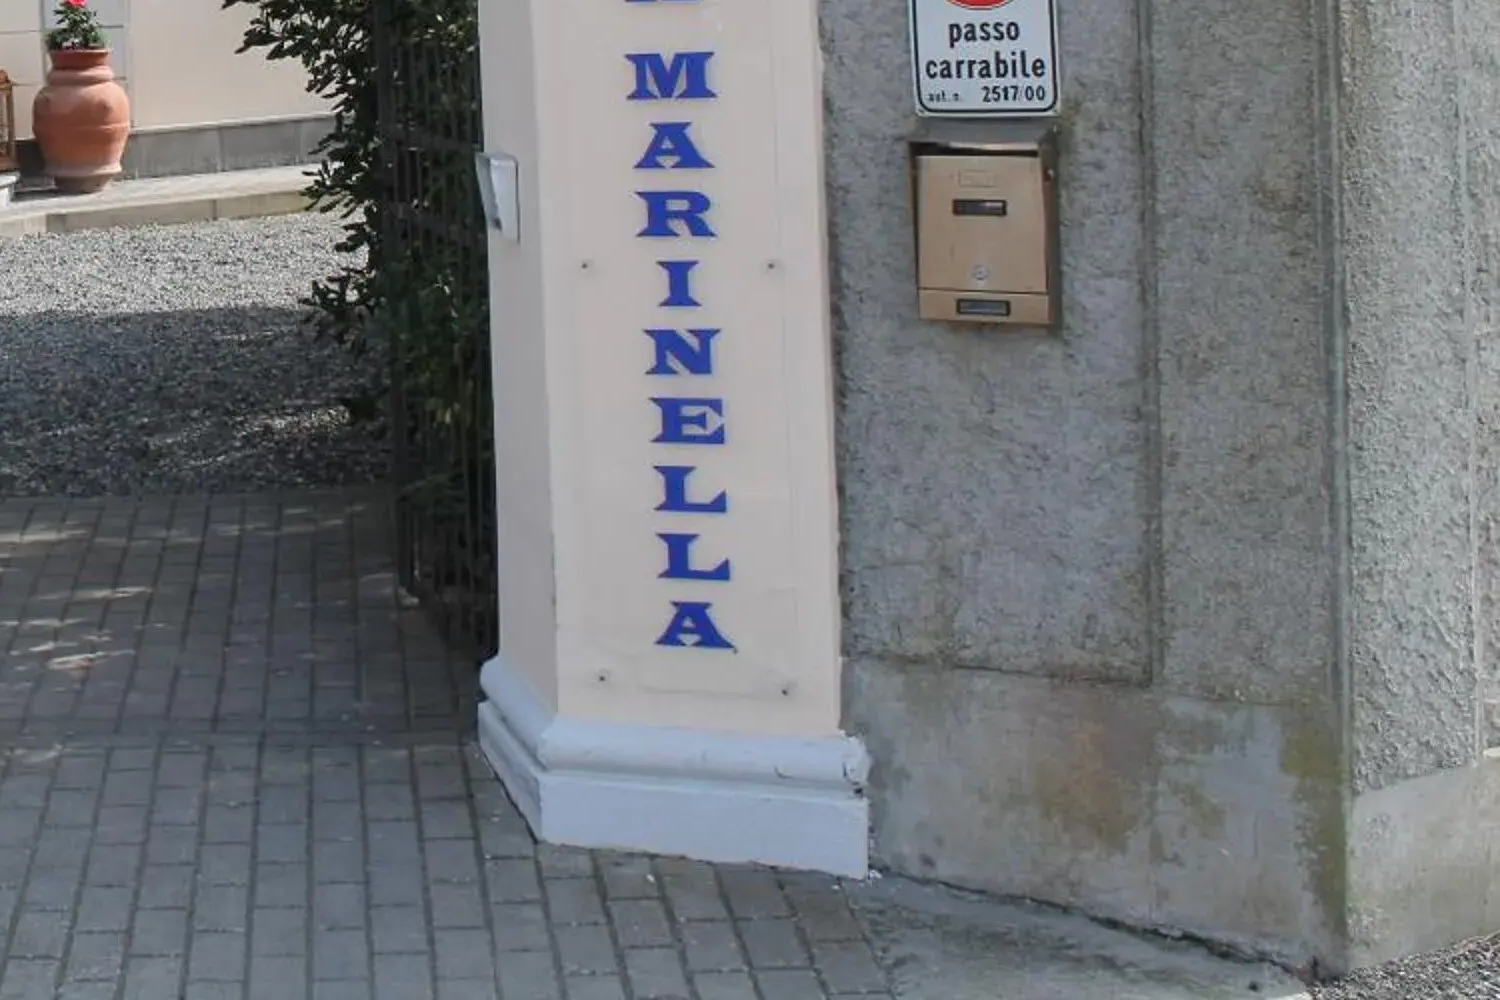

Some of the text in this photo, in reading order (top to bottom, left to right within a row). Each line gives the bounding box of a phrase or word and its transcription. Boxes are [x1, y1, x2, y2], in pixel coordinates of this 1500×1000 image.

[949, 21, 1020, 48] passo
[925, 50, 1046, 80] carrabile
[624, 50, 736, 652] MARINELLA
